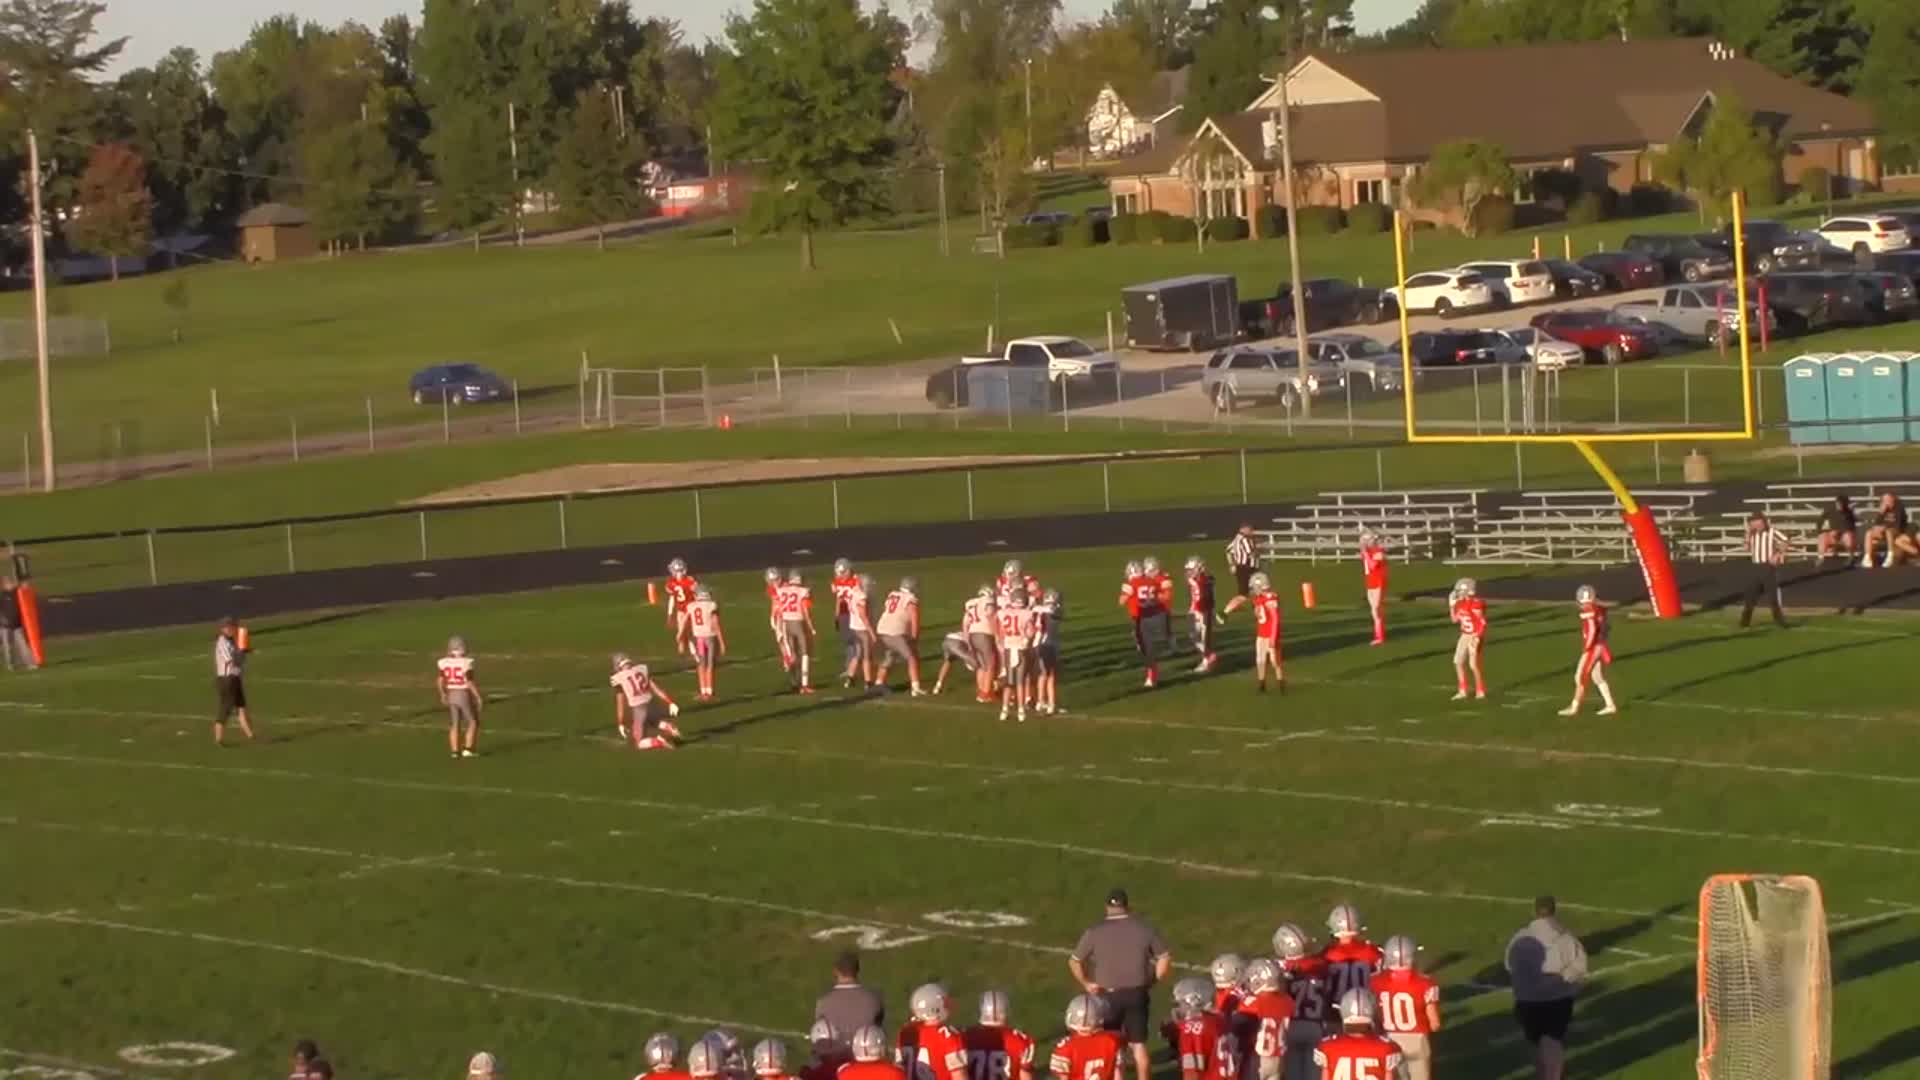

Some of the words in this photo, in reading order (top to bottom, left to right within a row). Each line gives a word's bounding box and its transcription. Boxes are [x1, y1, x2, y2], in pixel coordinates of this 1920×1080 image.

[674, 585, 686, 602] 3
[780, 592, 798, 612] 22
[694, 607, 704, 626] 8
[1002, 614, 1020, 636] 21
[627, 672, 650, 697] 12
[1379, 991, 1417, 1031] 10
